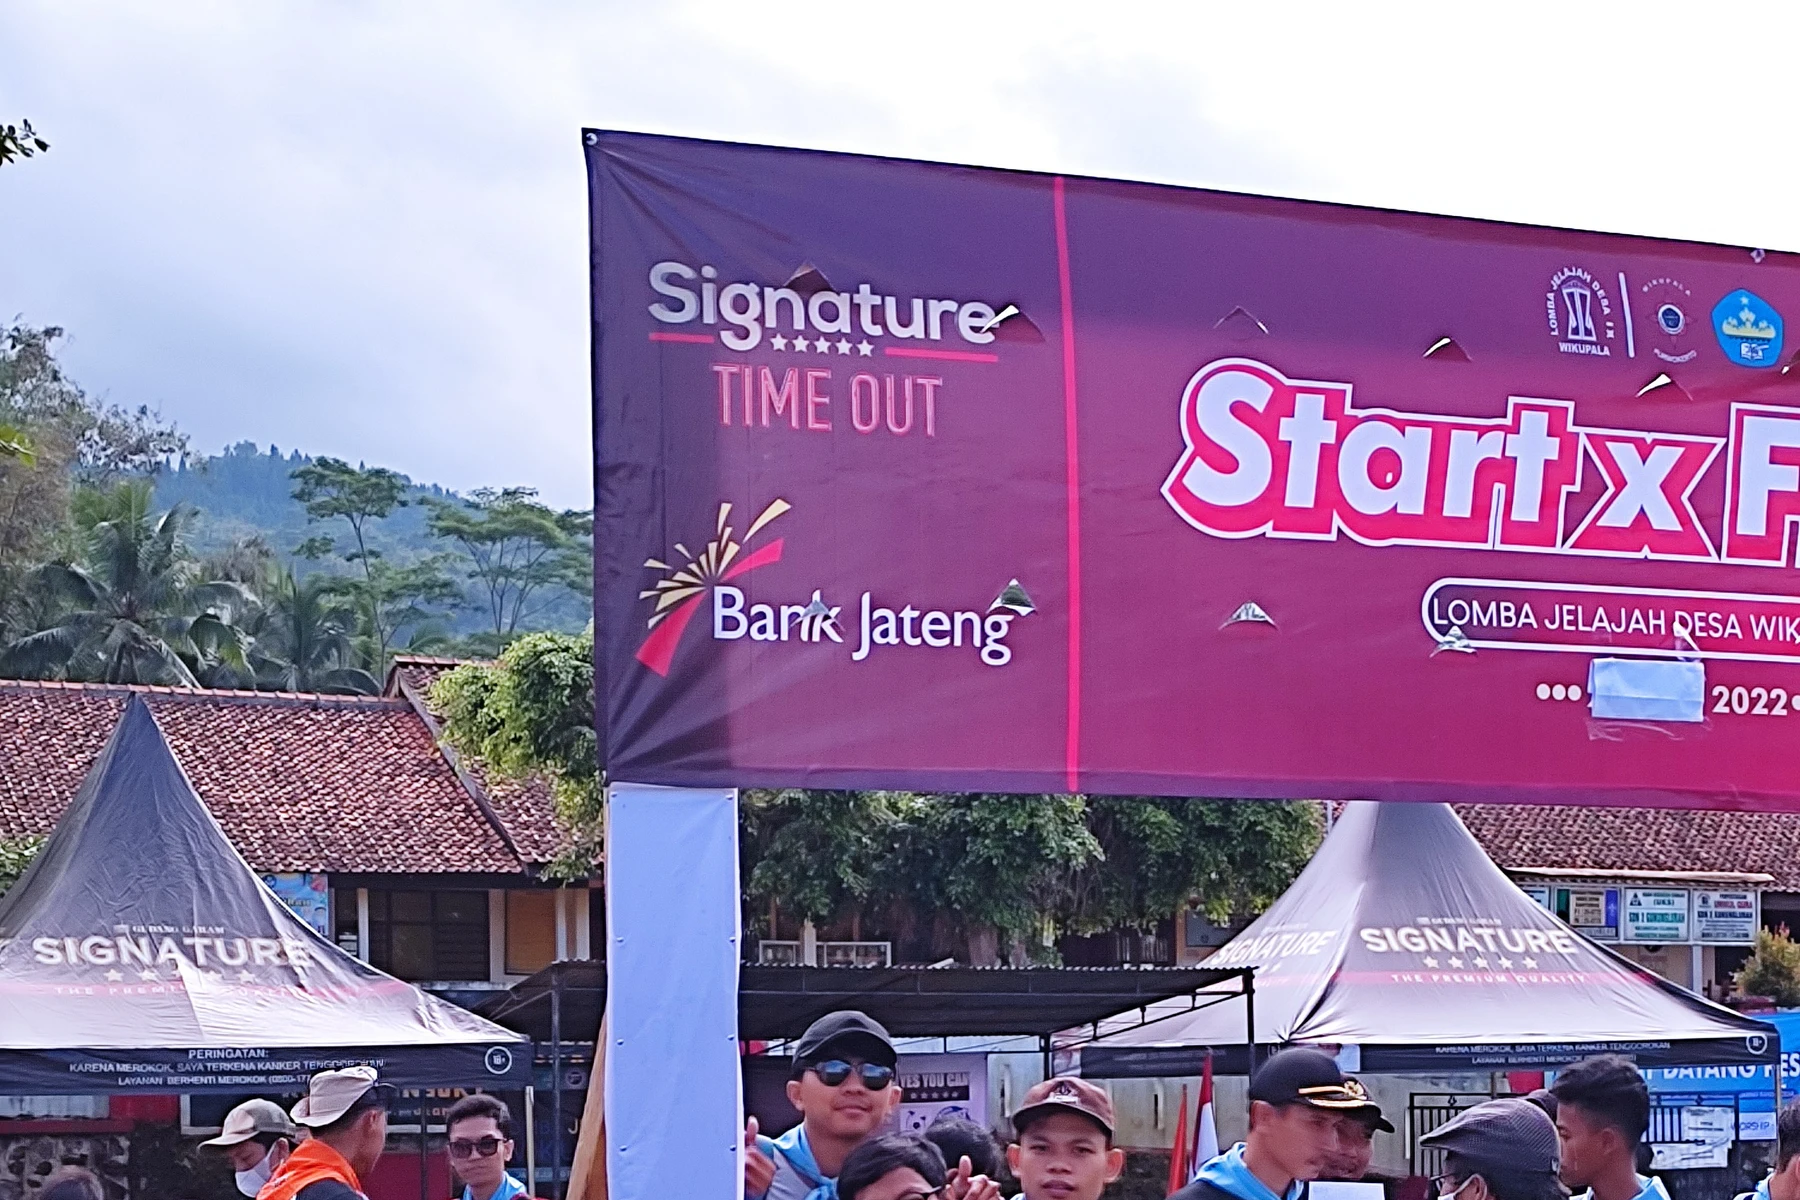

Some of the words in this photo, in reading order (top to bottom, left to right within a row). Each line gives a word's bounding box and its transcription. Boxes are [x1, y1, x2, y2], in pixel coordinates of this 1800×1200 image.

[646, 260, 1000, 352] Signature
[1546, 292, 1560, 337] LOMBA
[1558, 342, 1612, 357] WIKUPALA
[711, 362, 833, 432] TIME
[849, 372, 944, 437] OUT
[1176, 364, 1566, 528] Start
[713, 585, 845, 644] Bank
[851, 590, 1015, 667] Jateng
[1432, 597, 1538, 630] LOMBA
[1544, 603, 1666, 636] JELAJAH
[1673, 609, 1743, 640] DESA
[1711, 684, 1788, 717] 2022
[33, 936, 317, 968] SIGNATURE
[1210, 930, 1340, 965] SIGNATURE
[1359, 926, 1579, 954] SIGNATURE
[1391, 973, 1424, 984] THE
[1432, 974, 1508, 984] PREMIUM
[1516, 974, 1586, 985] QUALITY
[69, 1062, 115, 1073] KARENA
[176, 1062, 205, 1072] SAYA
[205, 1061, 257, 1072] TERKENA
[257, 1060, 301, 1071] KANKER
[188, 1049, 269, 1060] PERINGATAN:
[118, 1076, 163, 1086] LAYANAN
[167, 1075, 216, 1085] BERHENTI
[218, 1074, 267, 1084] MEROKOK
[899, 1073, 921, 1089] YES
[922, 1073, 945, 1089] YOU
